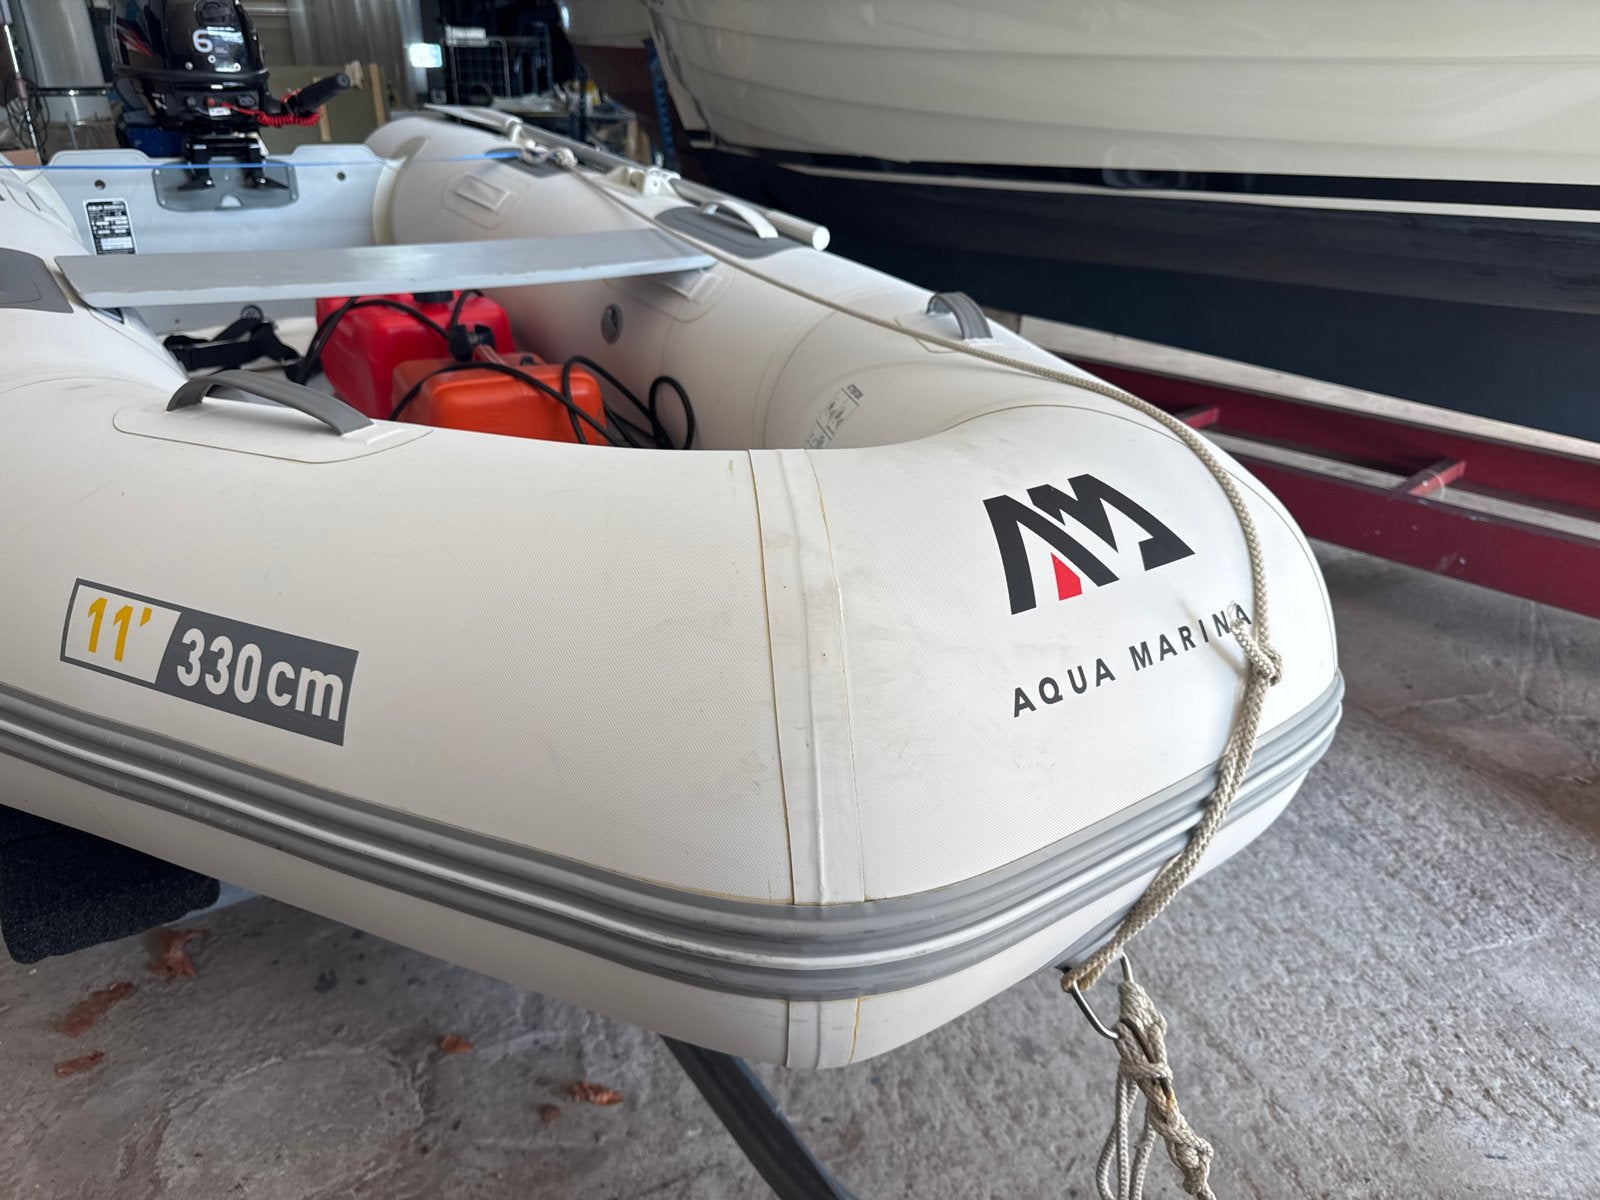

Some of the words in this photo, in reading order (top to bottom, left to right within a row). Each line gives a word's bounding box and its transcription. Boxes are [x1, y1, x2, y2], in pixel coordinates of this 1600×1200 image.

[192, 28, 214, 54] 6
[1013, 658, 1116, 718] AQUA
[1128, 603, 1252, 671] MARINA
